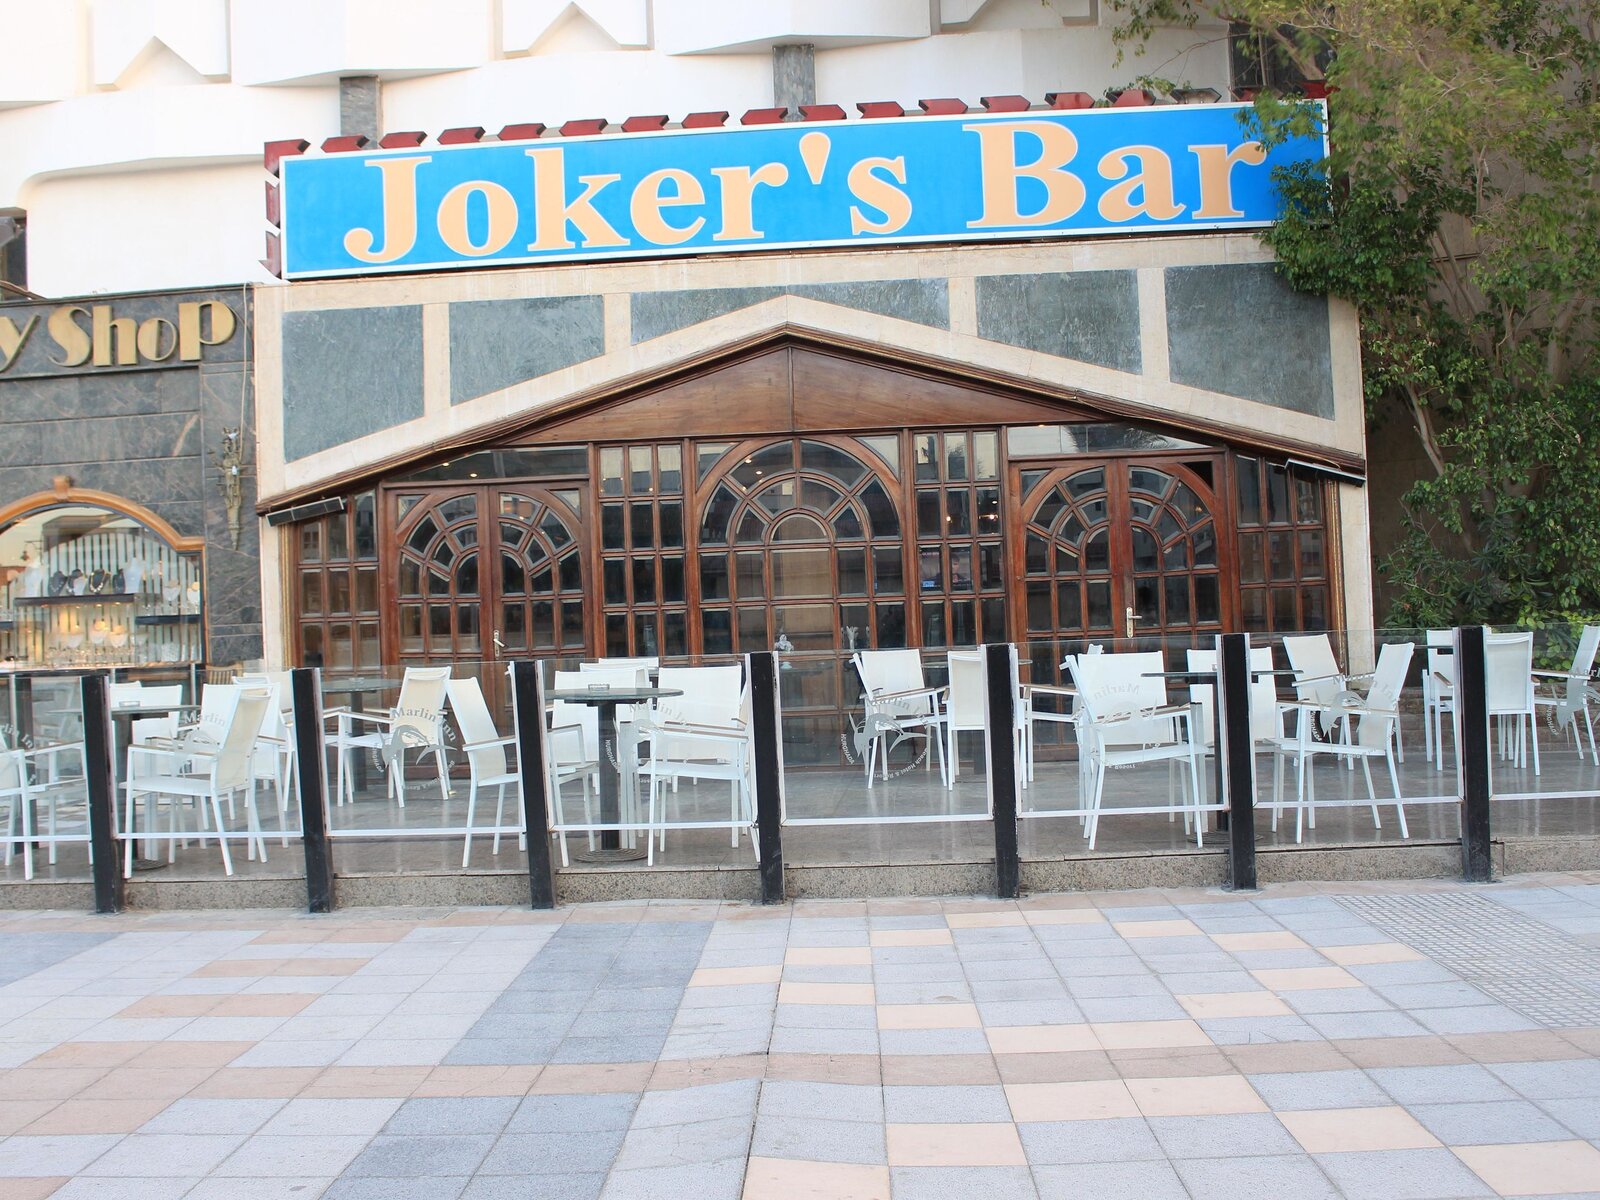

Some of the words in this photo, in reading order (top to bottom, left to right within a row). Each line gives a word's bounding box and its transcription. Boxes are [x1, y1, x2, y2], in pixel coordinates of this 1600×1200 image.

[343, 131, 912, 264] Joker's
[962, 120, 1268, 230] Bar
[184, 710, 226, 728] Marlin
[393, 707, 437, 723] Marlin
